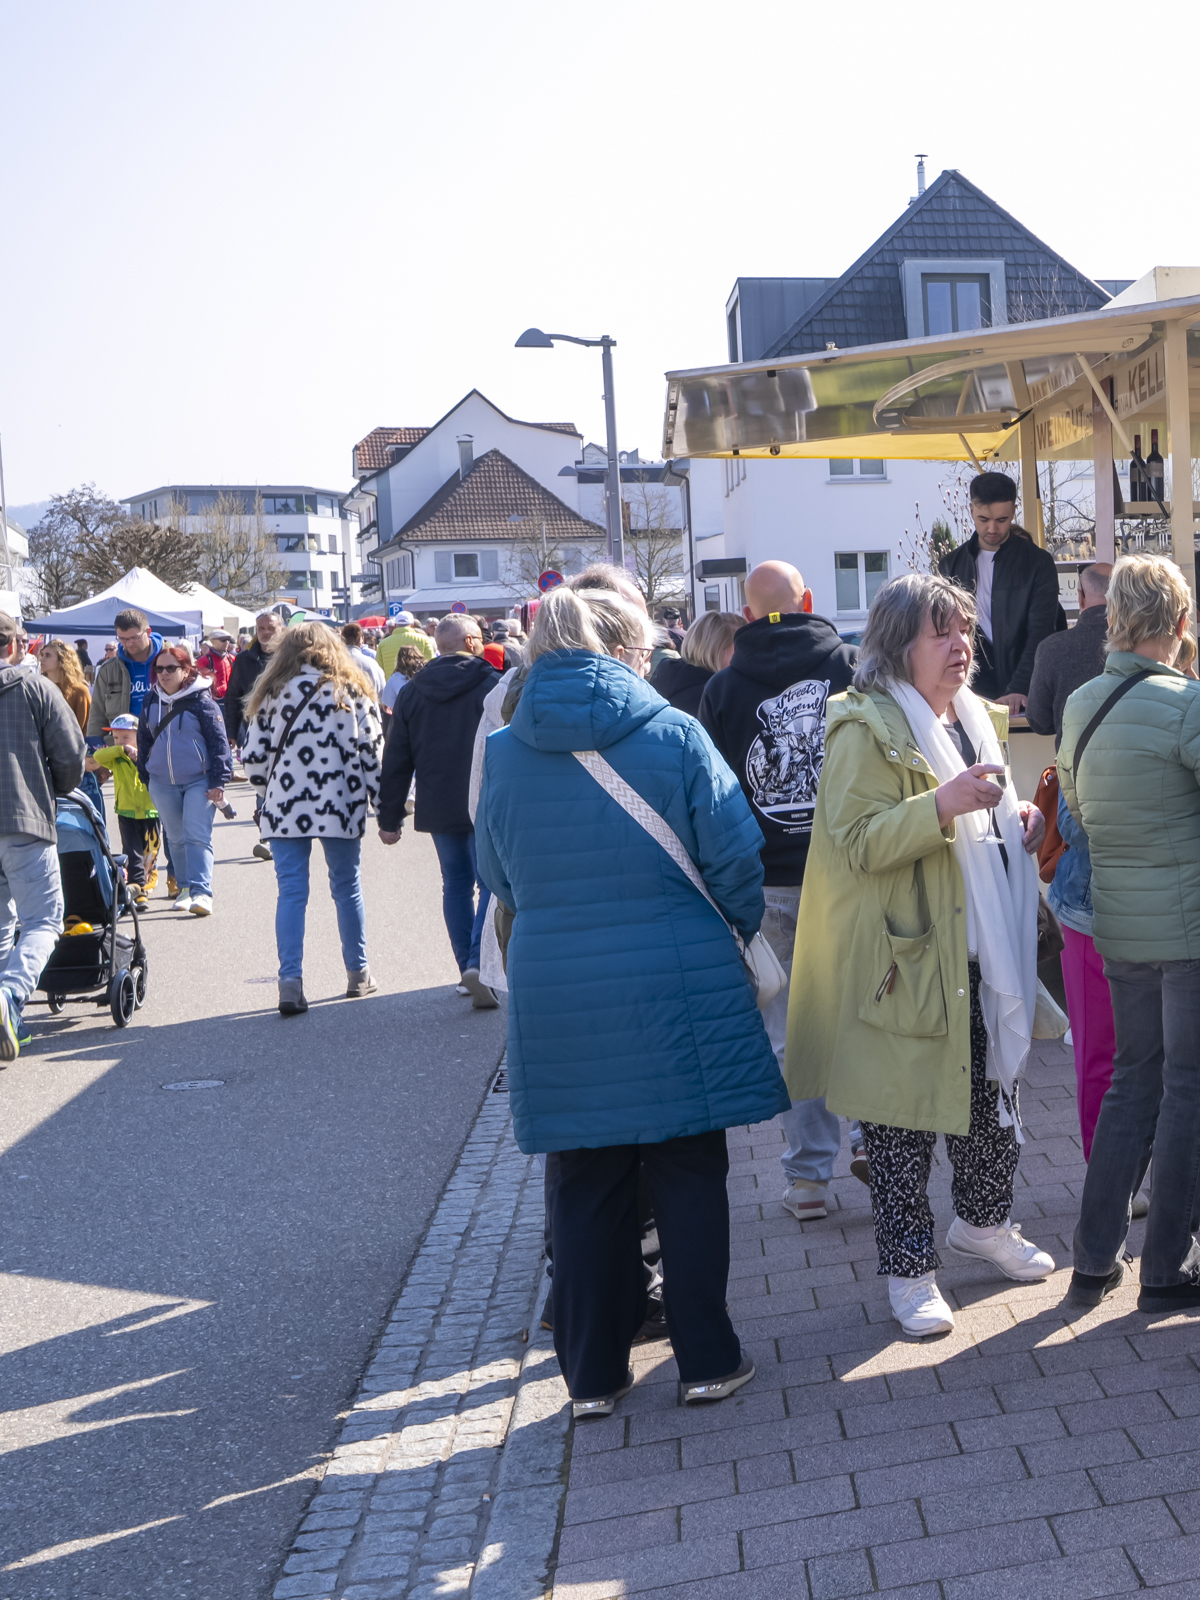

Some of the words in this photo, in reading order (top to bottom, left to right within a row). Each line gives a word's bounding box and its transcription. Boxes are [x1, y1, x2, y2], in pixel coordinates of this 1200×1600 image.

[1128, 348, 1165, 409] KELL
[1037, 404, 1084, 450] WEINGUT
[393, 607, 399, 615] P
[776, 683, 817, 709] Streets
